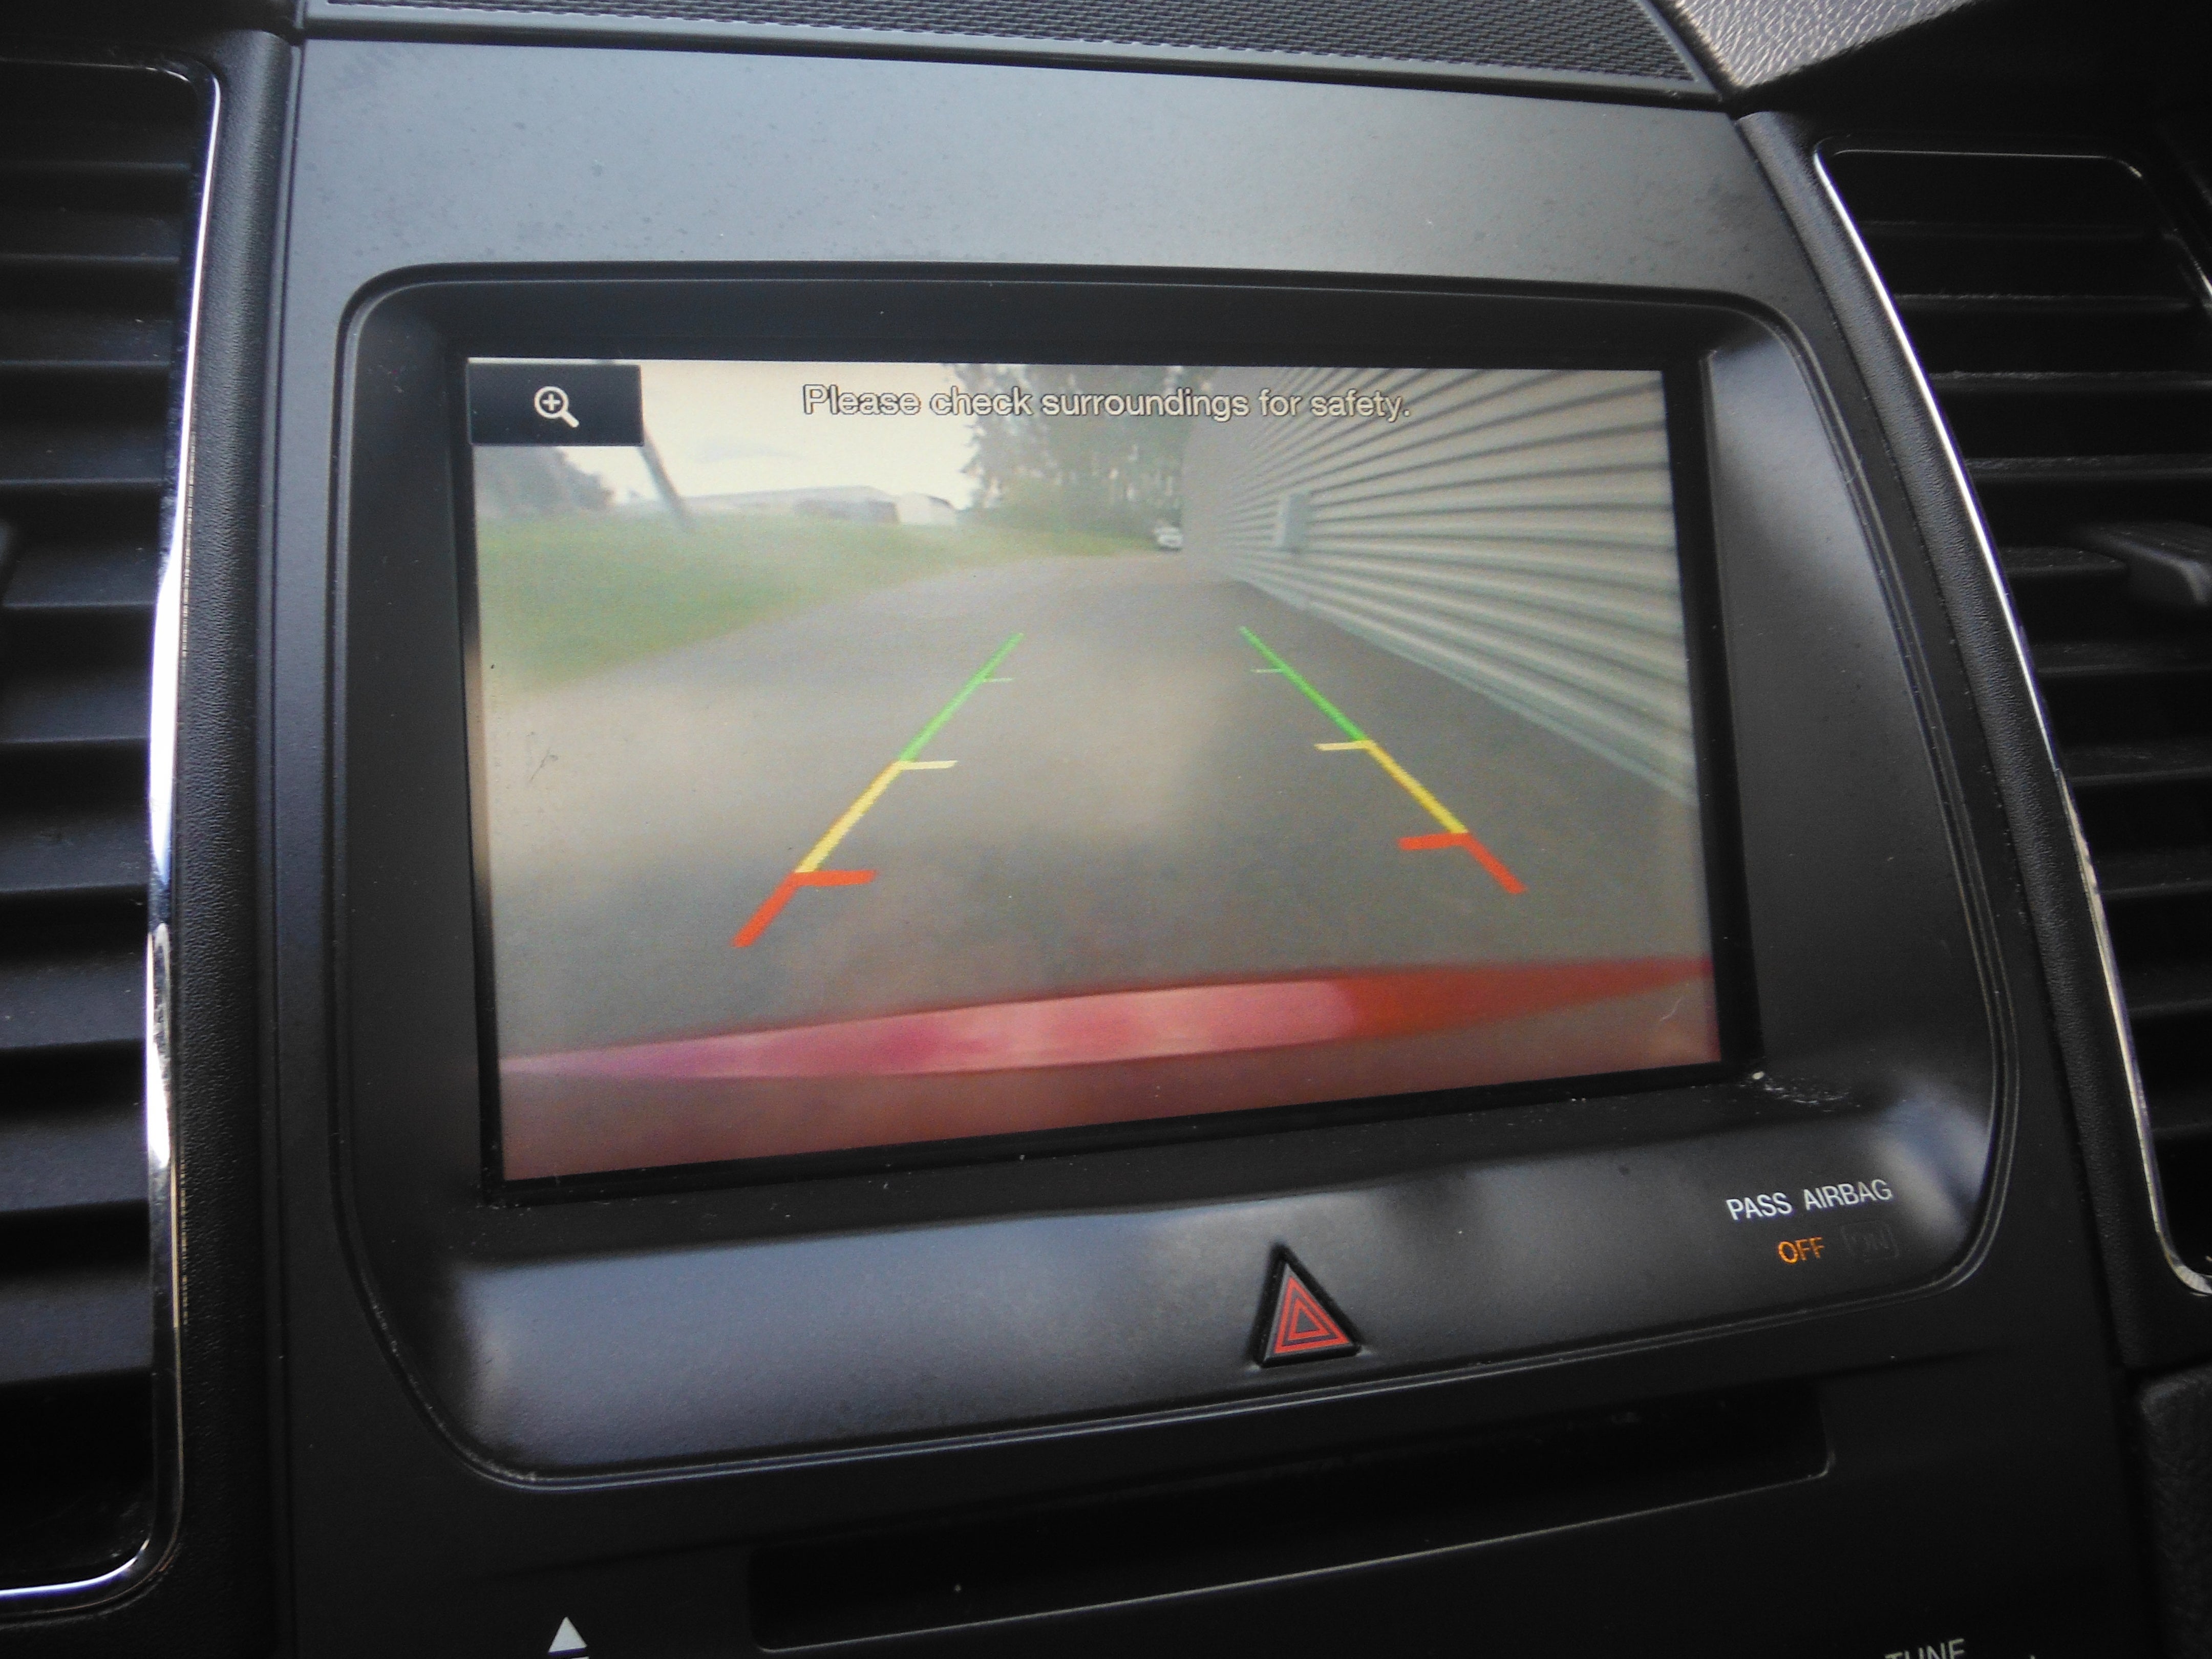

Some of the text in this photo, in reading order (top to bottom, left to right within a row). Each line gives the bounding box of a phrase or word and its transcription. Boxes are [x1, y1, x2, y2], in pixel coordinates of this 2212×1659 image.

[803, 384, 1411, 422] Please check surroundings for safety.
[1726, 1179, 1893, 1221] PASS AIRBAG
[1777, 1237, 1825, 1264] OFF
[1884, 1638, 1965, 1659] NE
